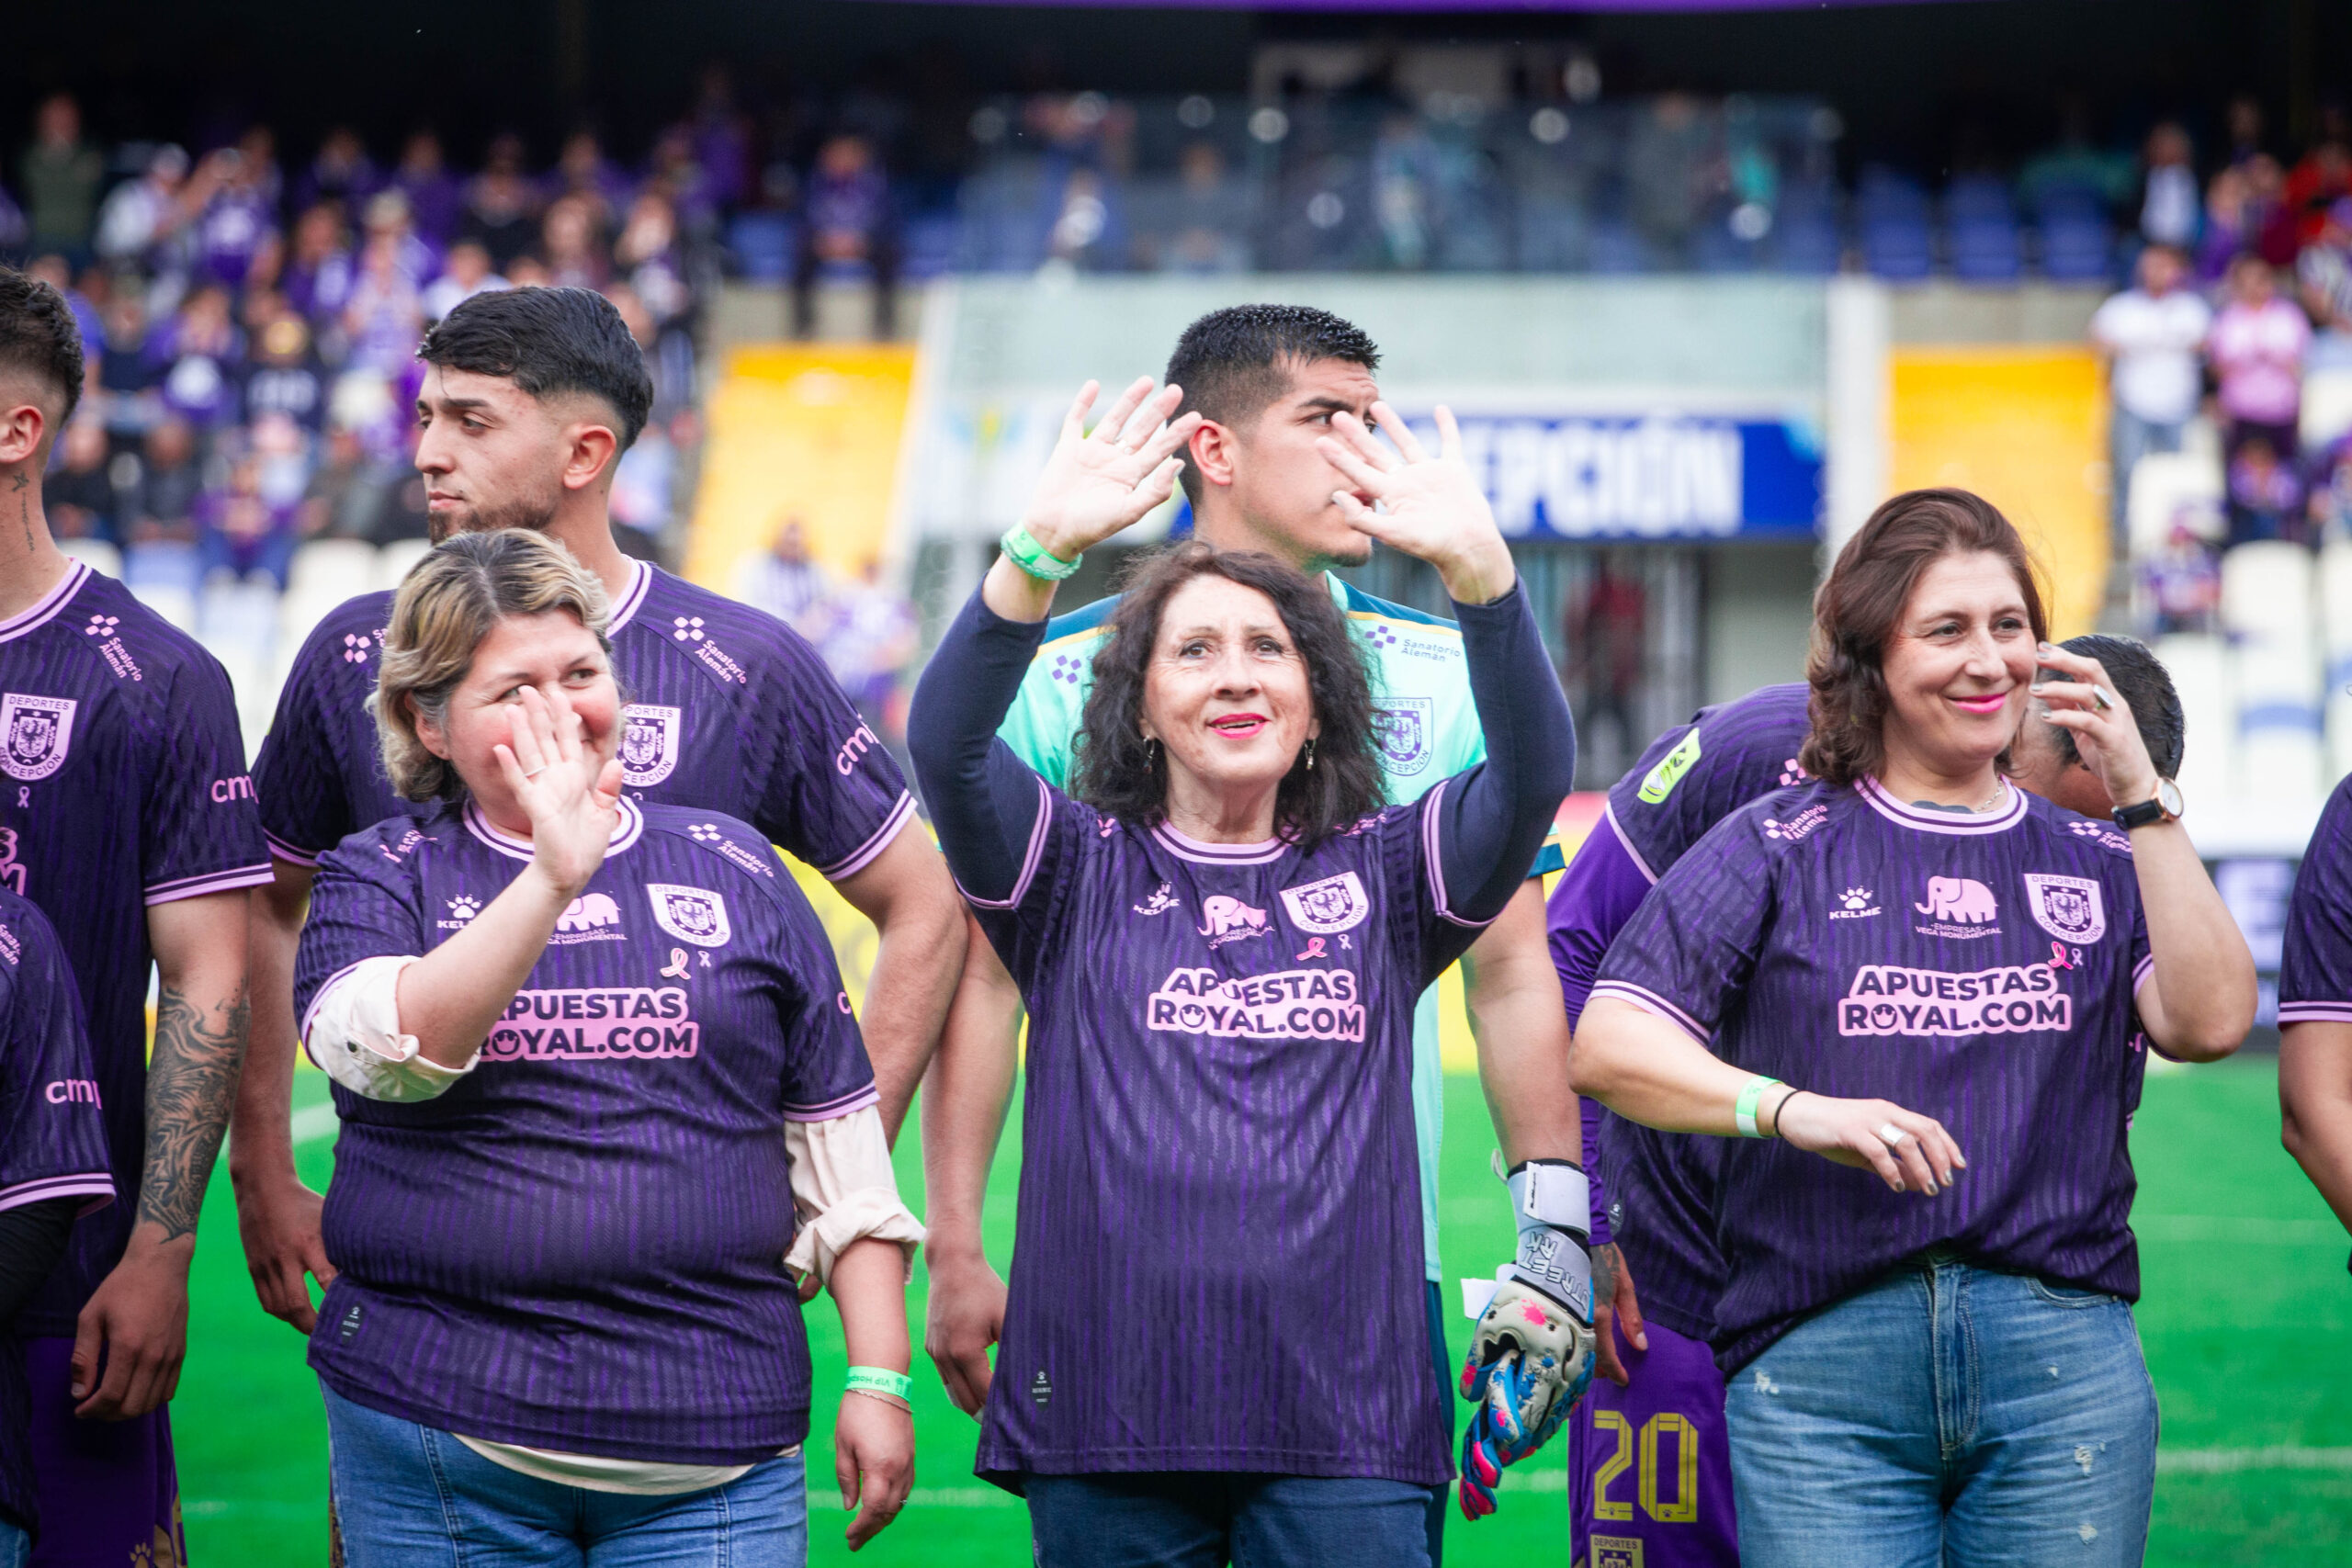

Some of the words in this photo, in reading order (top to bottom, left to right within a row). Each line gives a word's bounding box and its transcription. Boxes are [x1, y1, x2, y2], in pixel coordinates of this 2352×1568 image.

[109, 637, 142, 682] Sanatorio
[1403, 637, 1462, 658] Sanatorio
[98, 644, 127, 679] Alemán
[695, 648, 734, 682] Alemán
[702, 639, 747, 684] Sanatorio
[8, 695, 70, 711] DEPORTES
[626, 705, 673, 718] PORTES
[622, 760, 673, 784] CEPCION
[722, 840, 775, 878] Sanatorio
[654, 885, 718, 901] DEPORTES
[2031, 875, 2094, 890] DEPORTES
[436, 919, 473, 930] KEL
[1829, 906, 1883, 920] KELME
[663, 920, 728, 944] CONCEPCION
[1915, 926, 1939, 936] VEGA
[1939, 927, 2003, 940] MONUMENTAL
[2037, 915, 2102, 942] CONCEPCION
[1169, 972, 1352, 1008] APUESTAS
[1855, 968, 2052, 1001] APUESTAS
[500, 992, 683, 1021] PUESTAS
[1154, 998, 1361, 1037] ROYAL.COM
[1844, 998, 2066, 1031] ROYAL.COM
[1594, 1410, 1698, 1523] 20
[1594, 1537, 1639, 1551] DEPORTES
